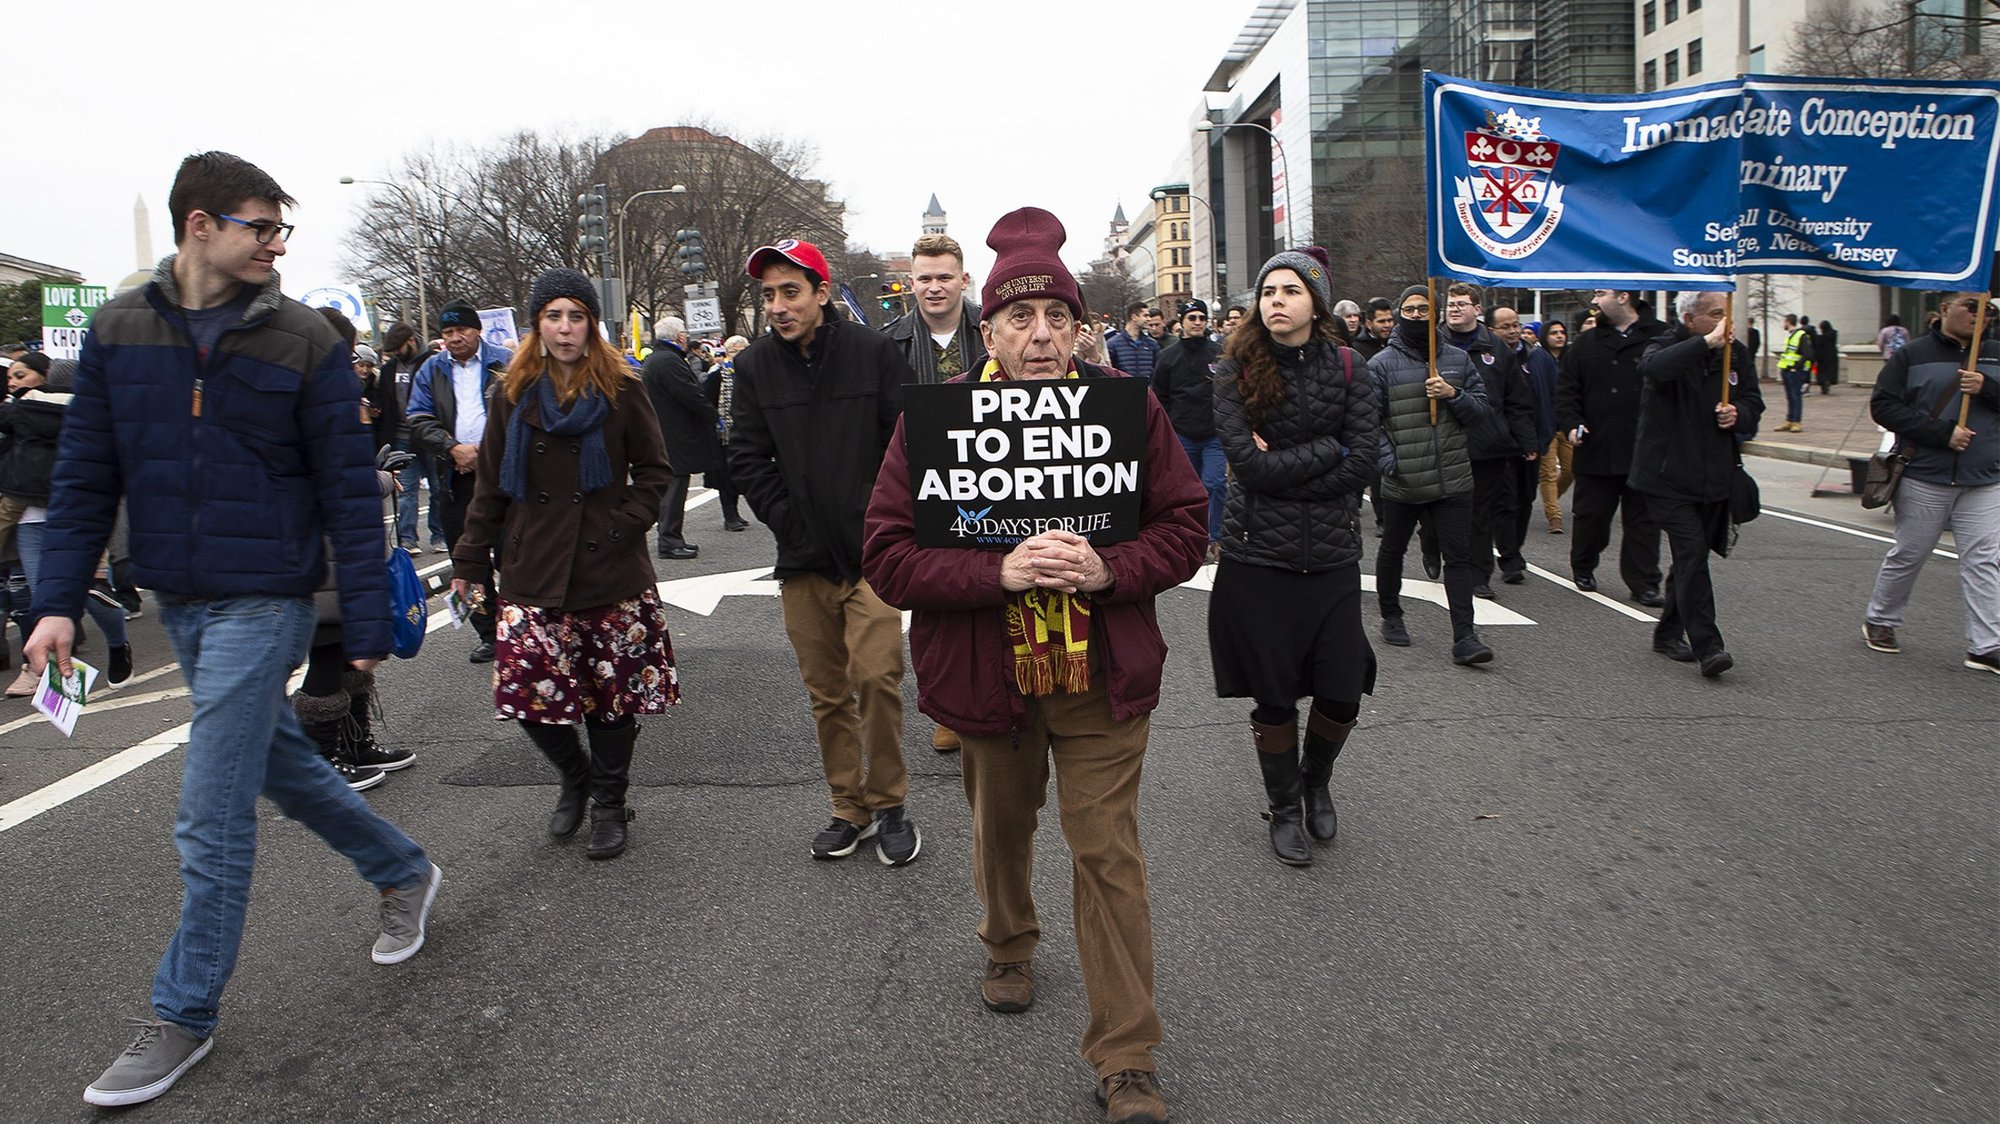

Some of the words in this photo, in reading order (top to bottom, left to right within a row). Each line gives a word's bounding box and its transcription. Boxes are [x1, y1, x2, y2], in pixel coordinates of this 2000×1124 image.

[1800, 96, 1976, 149] Conception
[1739, 155, 1848, 204] minary
[1704, 222, 1740, 242] Set
[1738, 208, 1760, 227] all
[1767, 209, 1872, 241] University
[1672, 248, 1737, 268] South
[1768, 233, 1820, 253] New
[1828, 242, 1898, 267] Jersey
[44, 286, 77, 307] LOVE
[80, 288, 107, 308] LIFE
[1011, 274, 1054, 288] UNIVERSITY
[1015, 285, 1028, 295] FOR
[1029, 283, 1046, 292] LIFE
[971, 385, 1090, 423] PRAY
[947, 428, 1011, 463] TO
[1022, 424, 1112, 461] END
[917, 460, 1139, 501] ABORTION
[983, 518, 1032, 536] DAYS
[1033, 517, 1079, 536] FOR
[1077, 512, 1112, 534] LIFE
